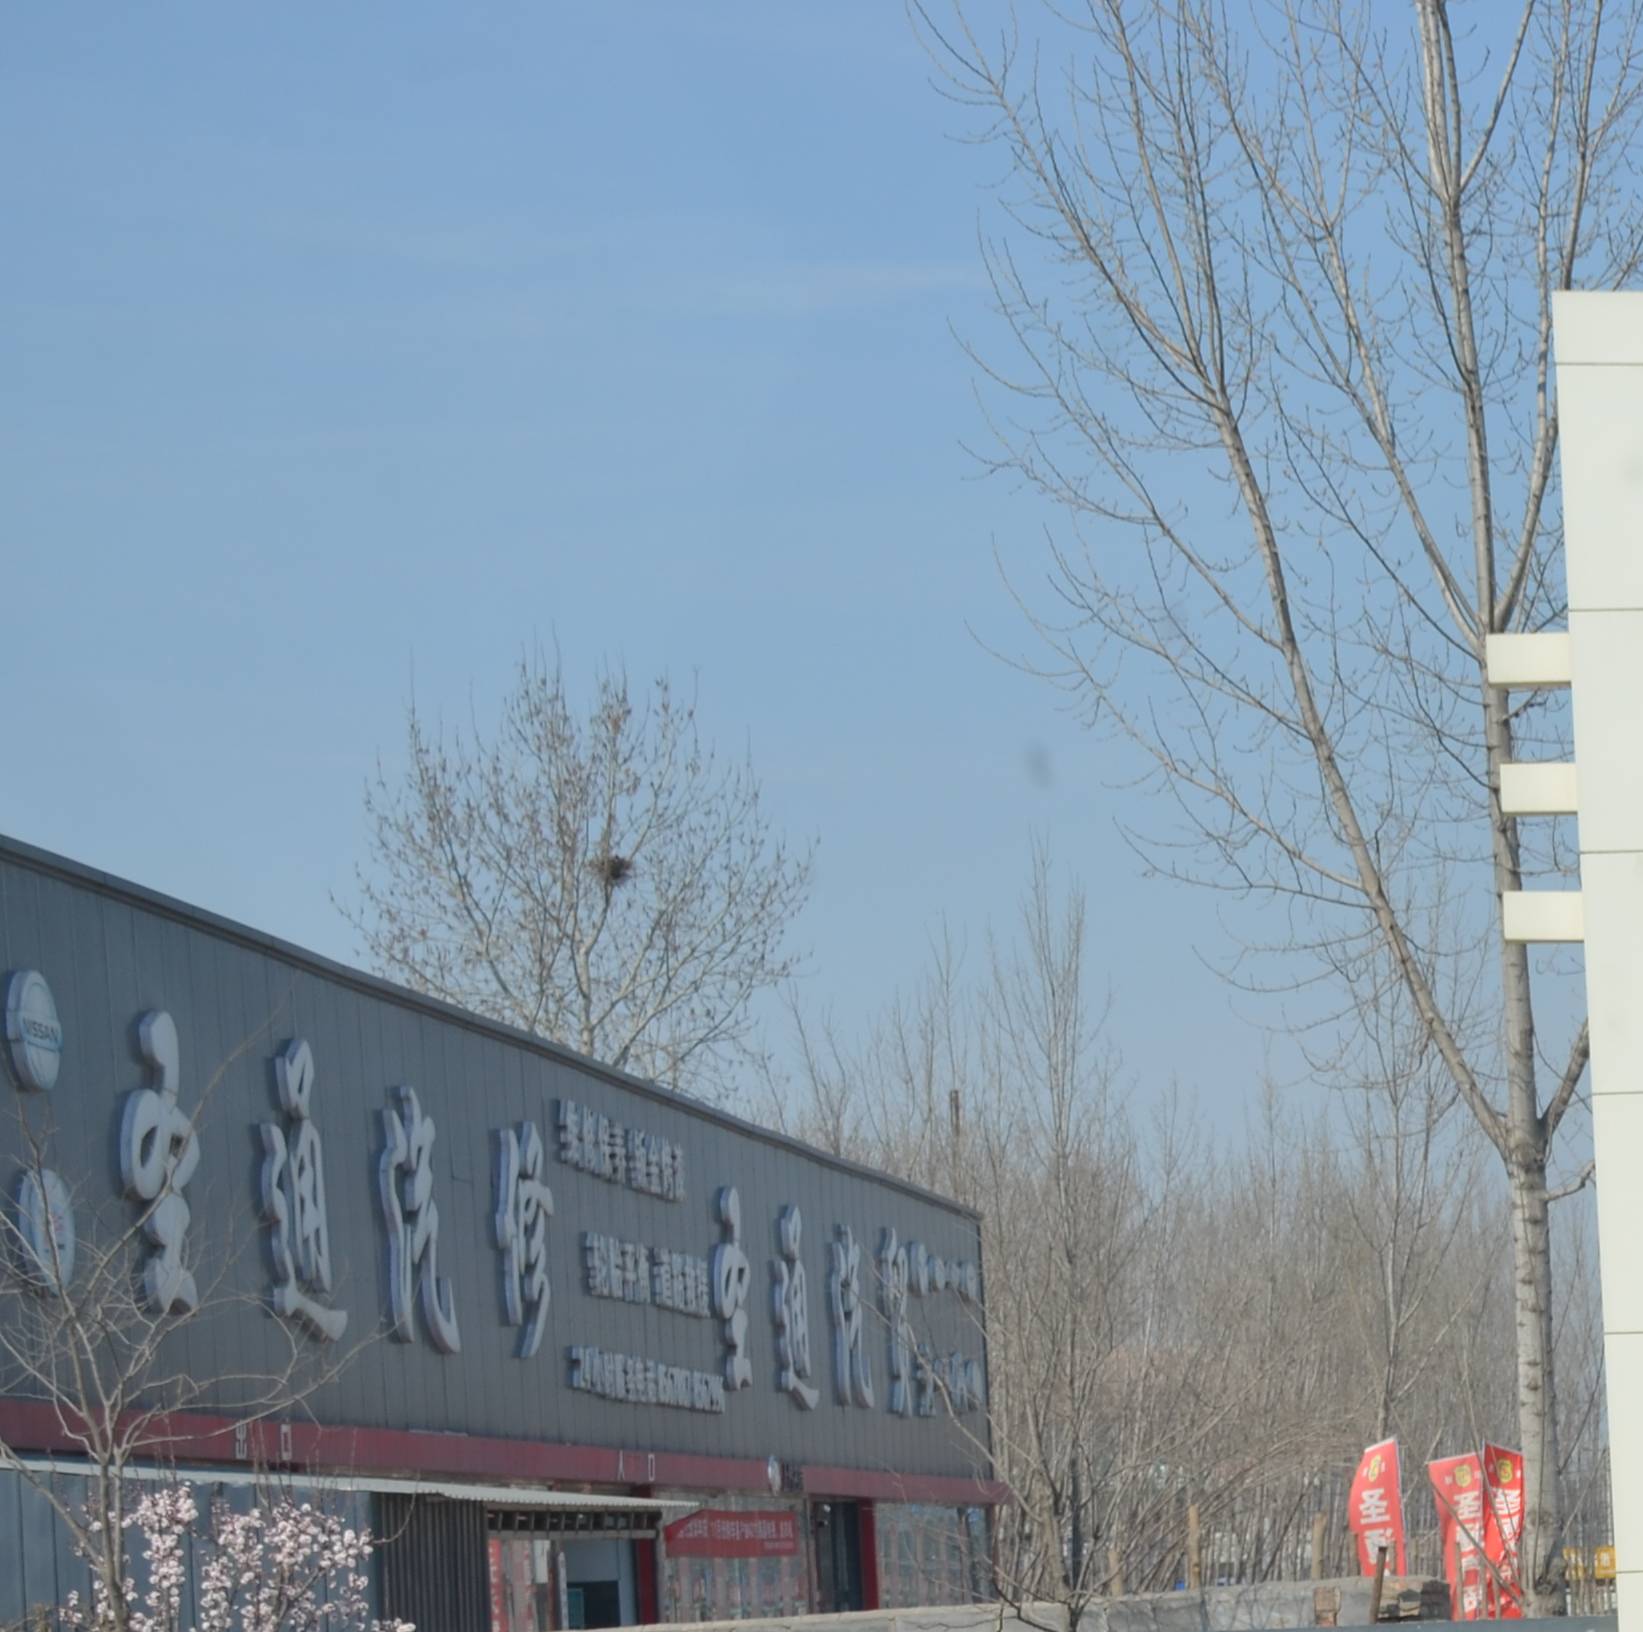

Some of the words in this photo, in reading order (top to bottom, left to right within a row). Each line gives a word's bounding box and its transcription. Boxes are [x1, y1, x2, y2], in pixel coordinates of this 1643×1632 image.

[22, 1016, 59, 1044] NISSAN
[235, 1418, 291, 1461] 出口
[617, 1450, 656, 1482] 入口
